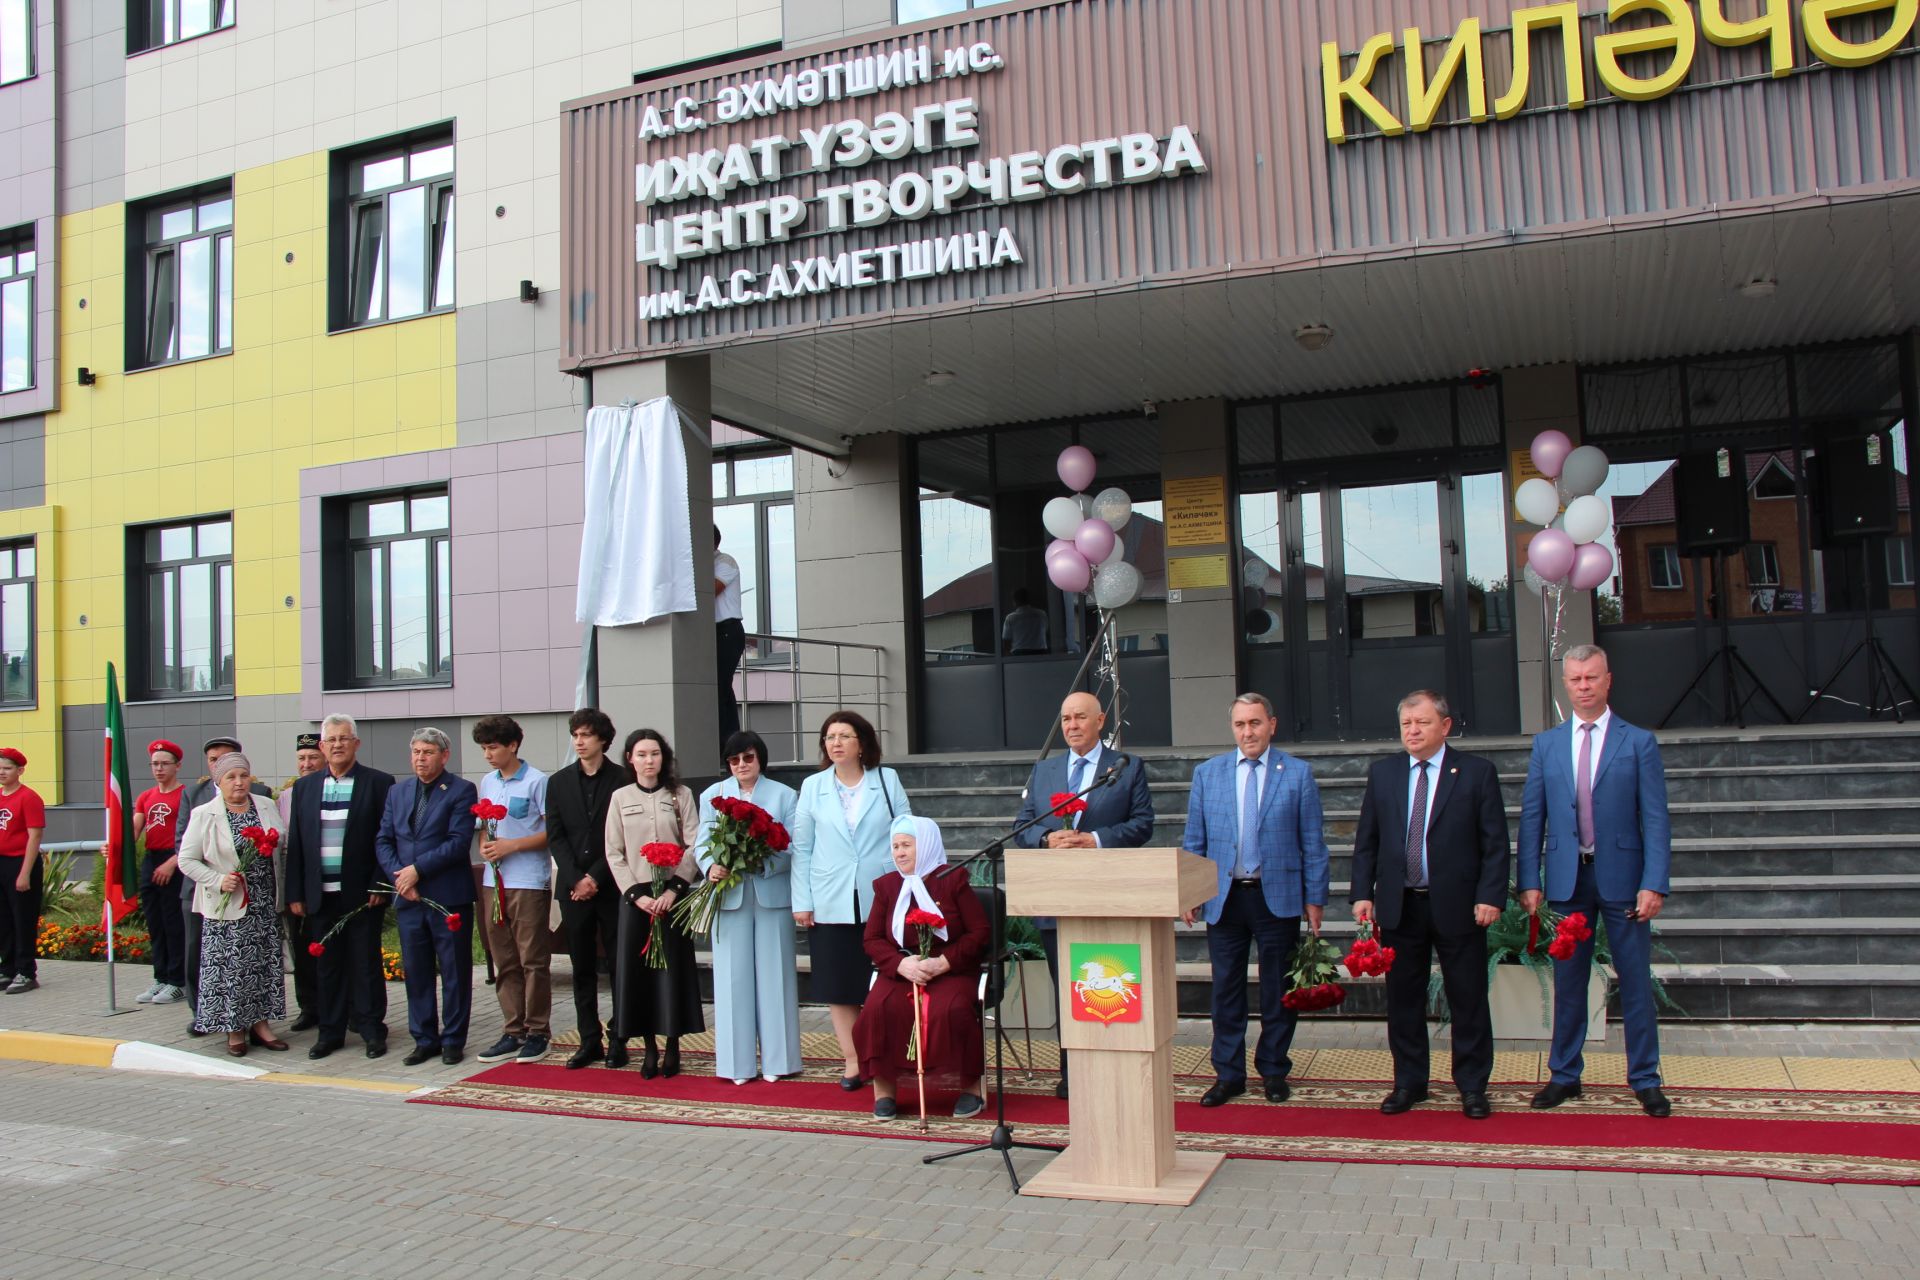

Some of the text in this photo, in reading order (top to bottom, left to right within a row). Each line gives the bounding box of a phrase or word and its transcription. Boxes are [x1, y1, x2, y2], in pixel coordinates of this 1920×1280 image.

[716, 44, 932, 124] ӘХМӘТШИН
[944, 41, 1004, 80] ис.
[635, 97, 980, 206] ИҖАТ ҮЗӘГЕ
[635, 124, 1208, 270] ЦЕНТР ТВОРЧЕСТВА
